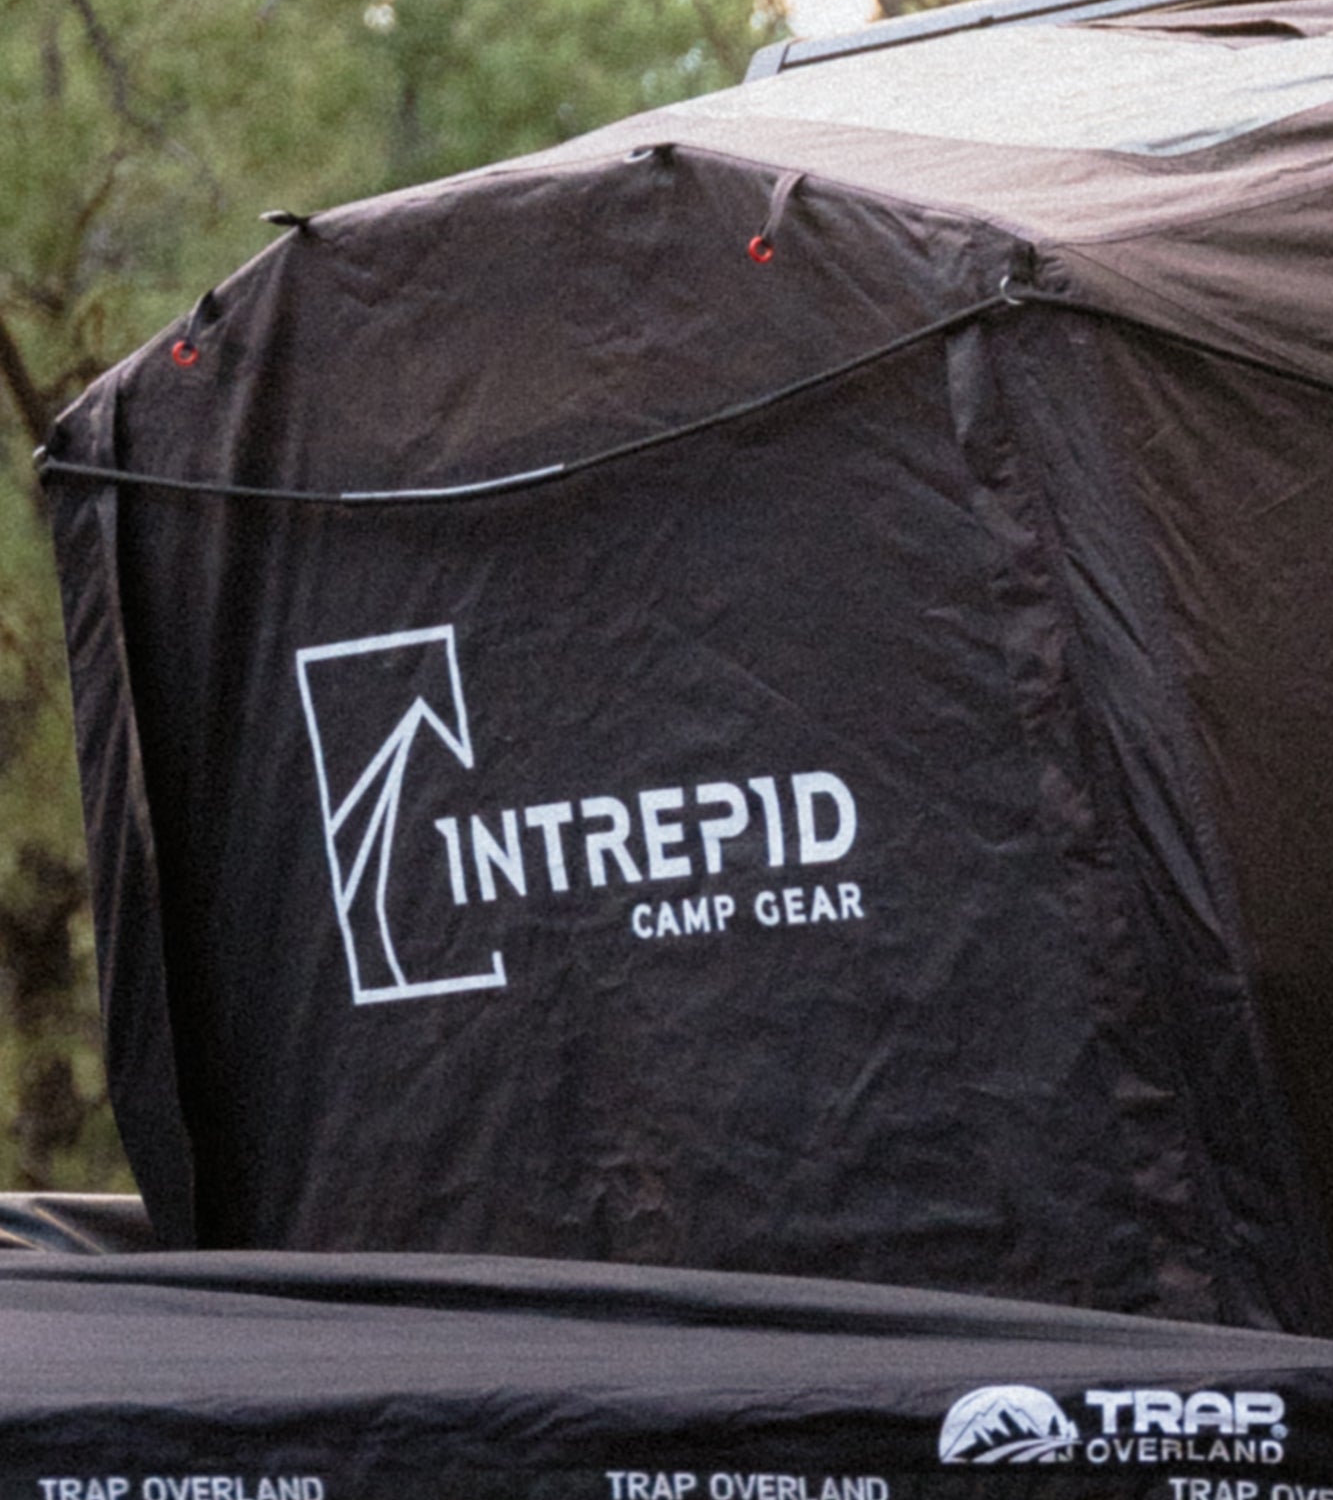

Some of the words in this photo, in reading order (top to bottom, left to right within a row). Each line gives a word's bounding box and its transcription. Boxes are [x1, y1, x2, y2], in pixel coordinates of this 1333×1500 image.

[434, 770, 859, 905] INTREPID
[632, 894, 737, 940] CAMP
[755, 881, 865, 927] GEAR
[1085, 1389, 1286, 1435] TRAP
[1085, 1438, 1285, 1465] OVERLAND
[605, 1471, 697, 1500] TRAP
